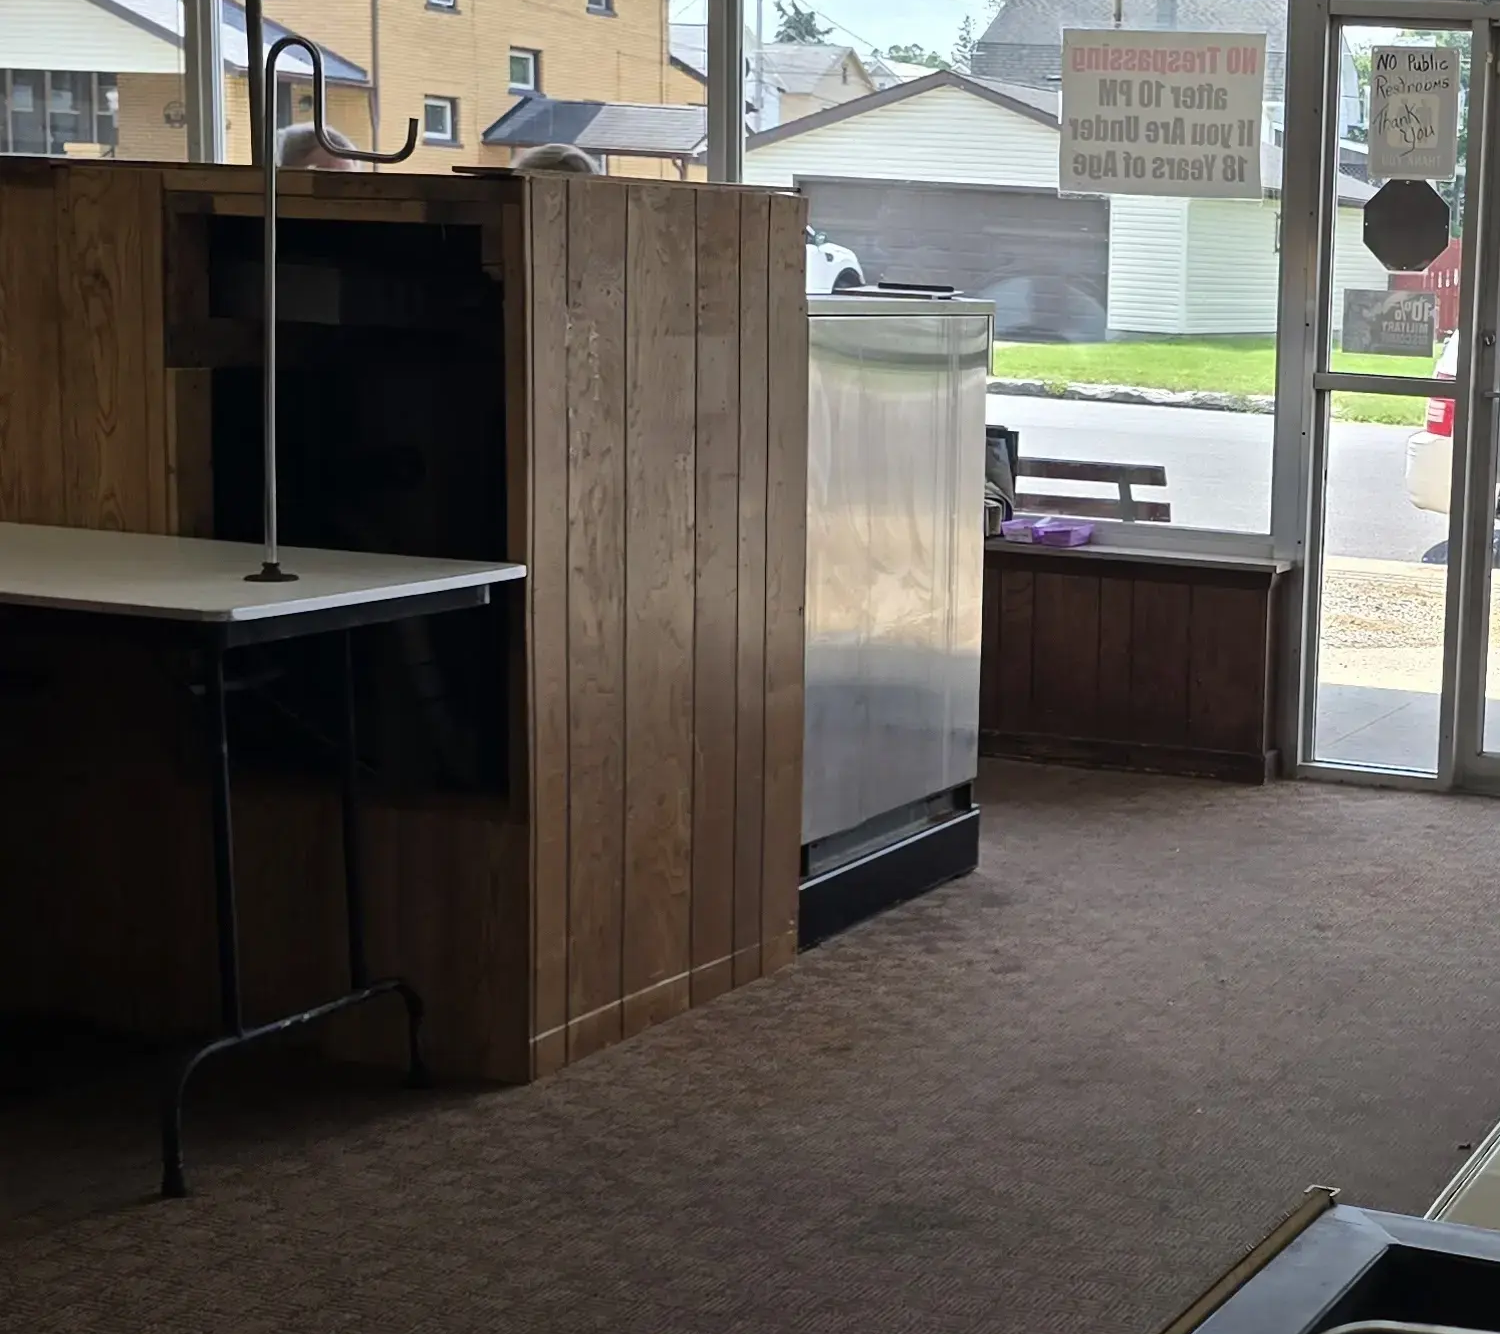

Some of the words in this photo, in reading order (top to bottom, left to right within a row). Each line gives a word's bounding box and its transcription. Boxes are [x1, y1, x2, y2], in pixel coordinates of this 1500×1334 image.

[1377, 54, 1397, 70] NO
[1408, 53, 1449, 72] Public
[1372, 103, 1420, 135] Thank
